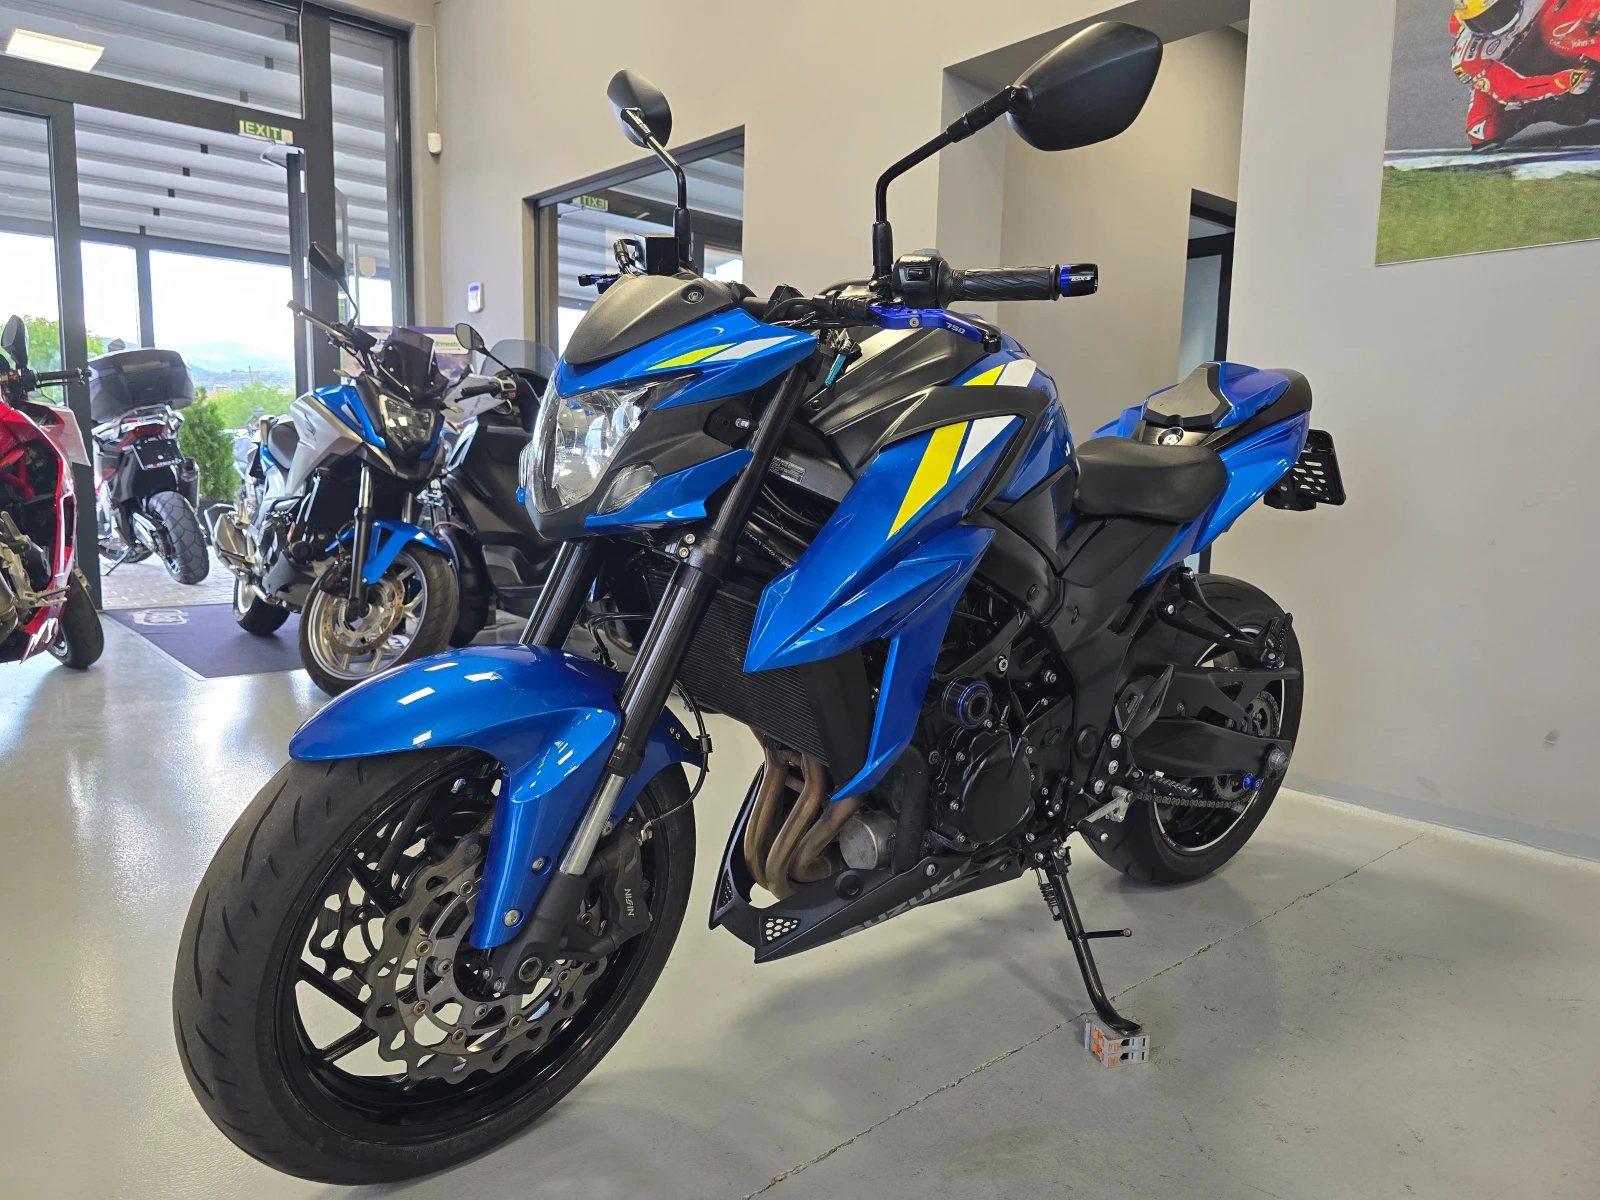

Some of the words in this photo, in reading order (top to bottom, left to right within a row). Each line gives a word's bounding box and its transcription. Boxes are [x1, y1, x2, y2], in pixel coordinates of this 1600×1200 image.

[245, 121, 280, 139] EXIT
[946, 321, 966, 334] 750
[841, 868, 961, 936] SUZUKI
